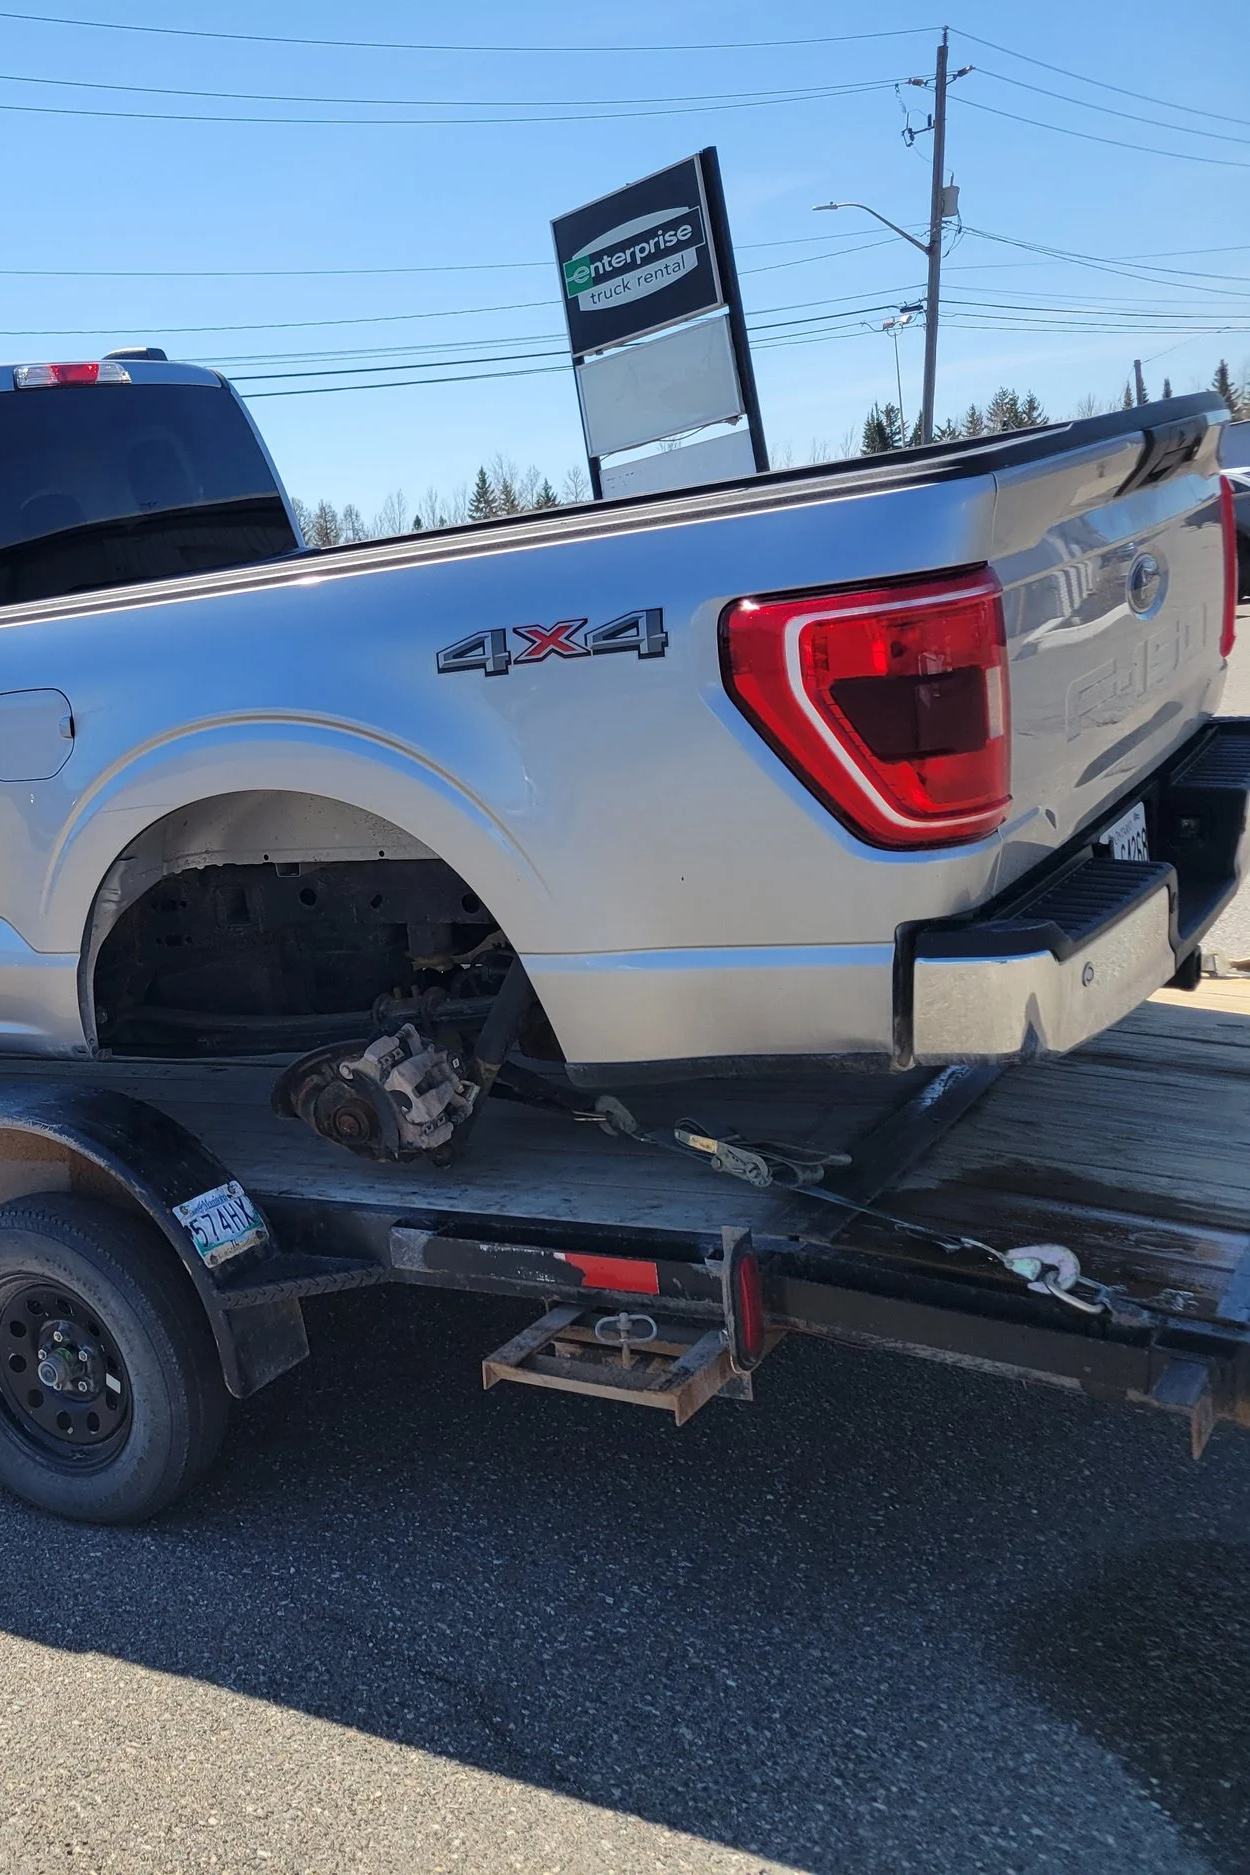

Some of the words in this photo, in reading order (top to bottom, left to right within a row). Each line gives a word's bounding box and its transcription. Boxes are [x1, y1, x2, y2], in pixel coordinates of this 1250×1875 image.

[571, 224, 693, 284] enterprise
[590, 278, 631, 305] truck
[637, 254, 686, 287] rental
[190, 1197, 256, 1248] 574HX
